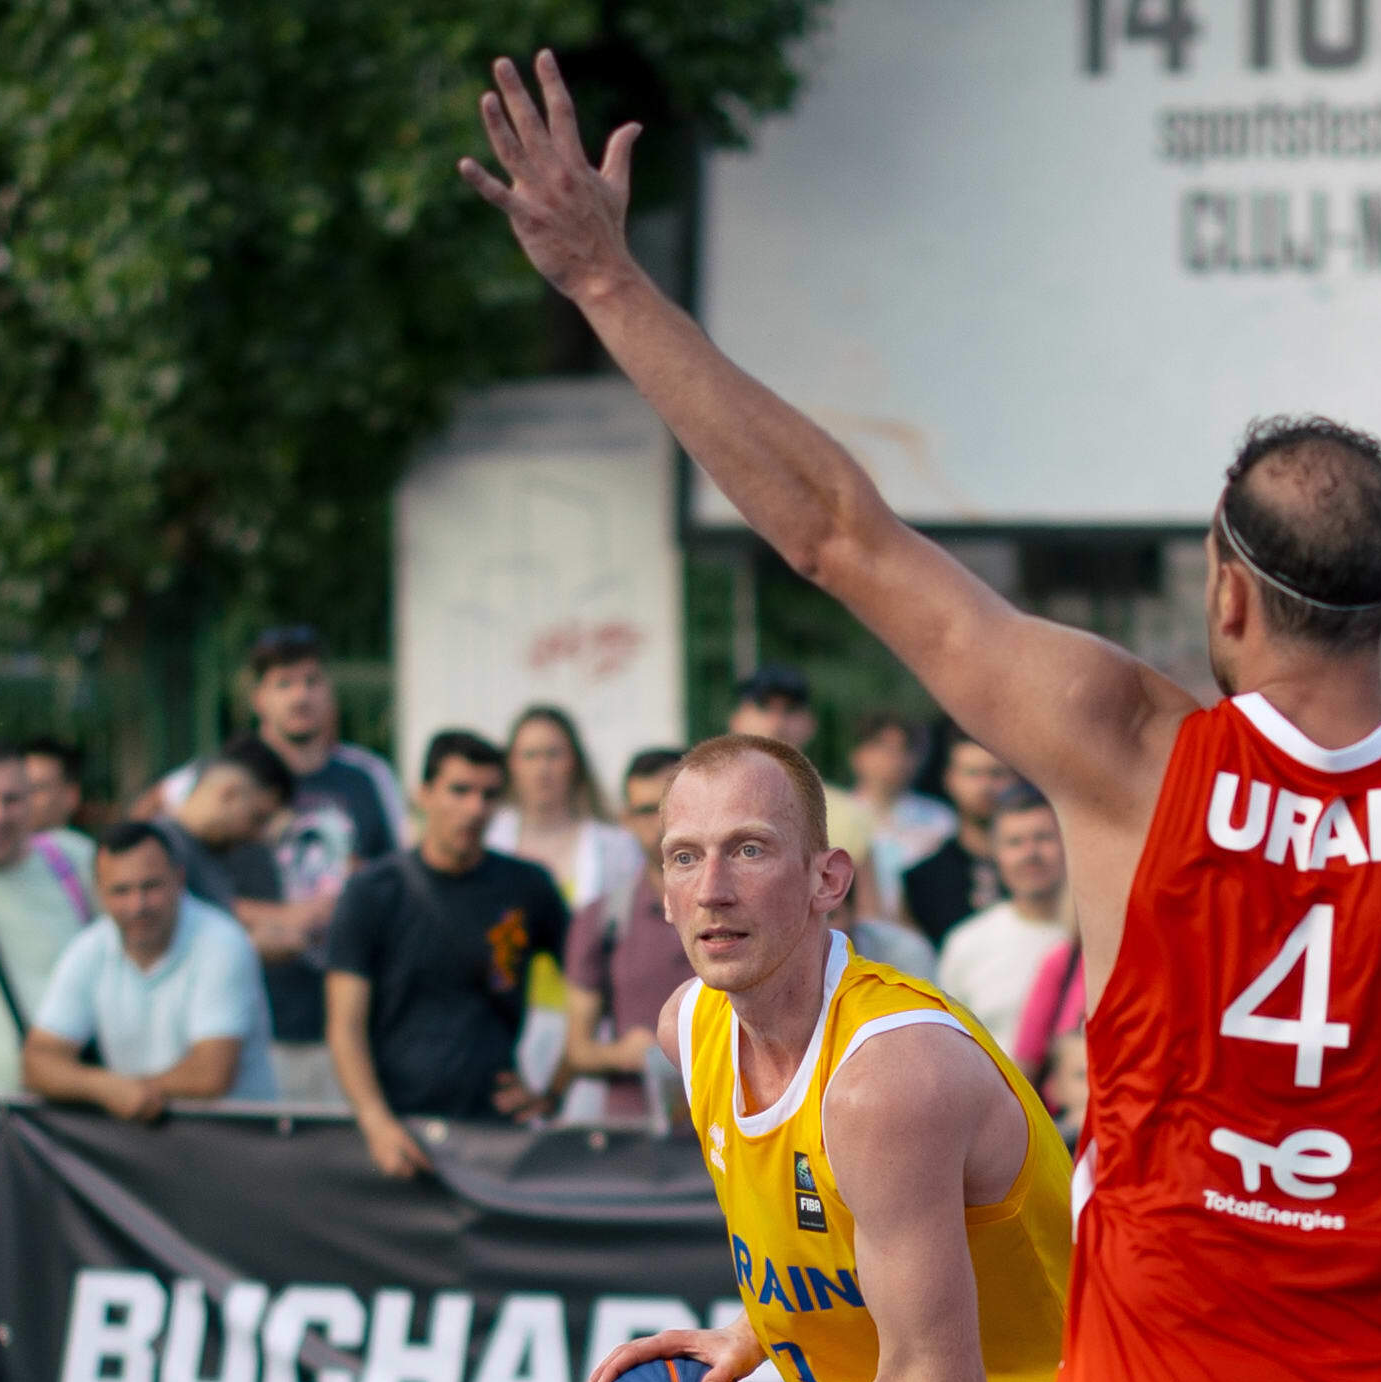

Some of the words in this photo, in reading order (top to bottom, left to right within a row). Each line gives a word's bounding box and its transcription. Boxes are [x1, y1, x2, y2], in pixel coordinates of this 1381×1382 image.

[1219, 904, 1350, 1088] 4
[800, 1197, 821, 1213] FIBA
[1202, 1189, 1346, 1231] TotalEnergies
[732, 1233, 865, 1313] RAIN
